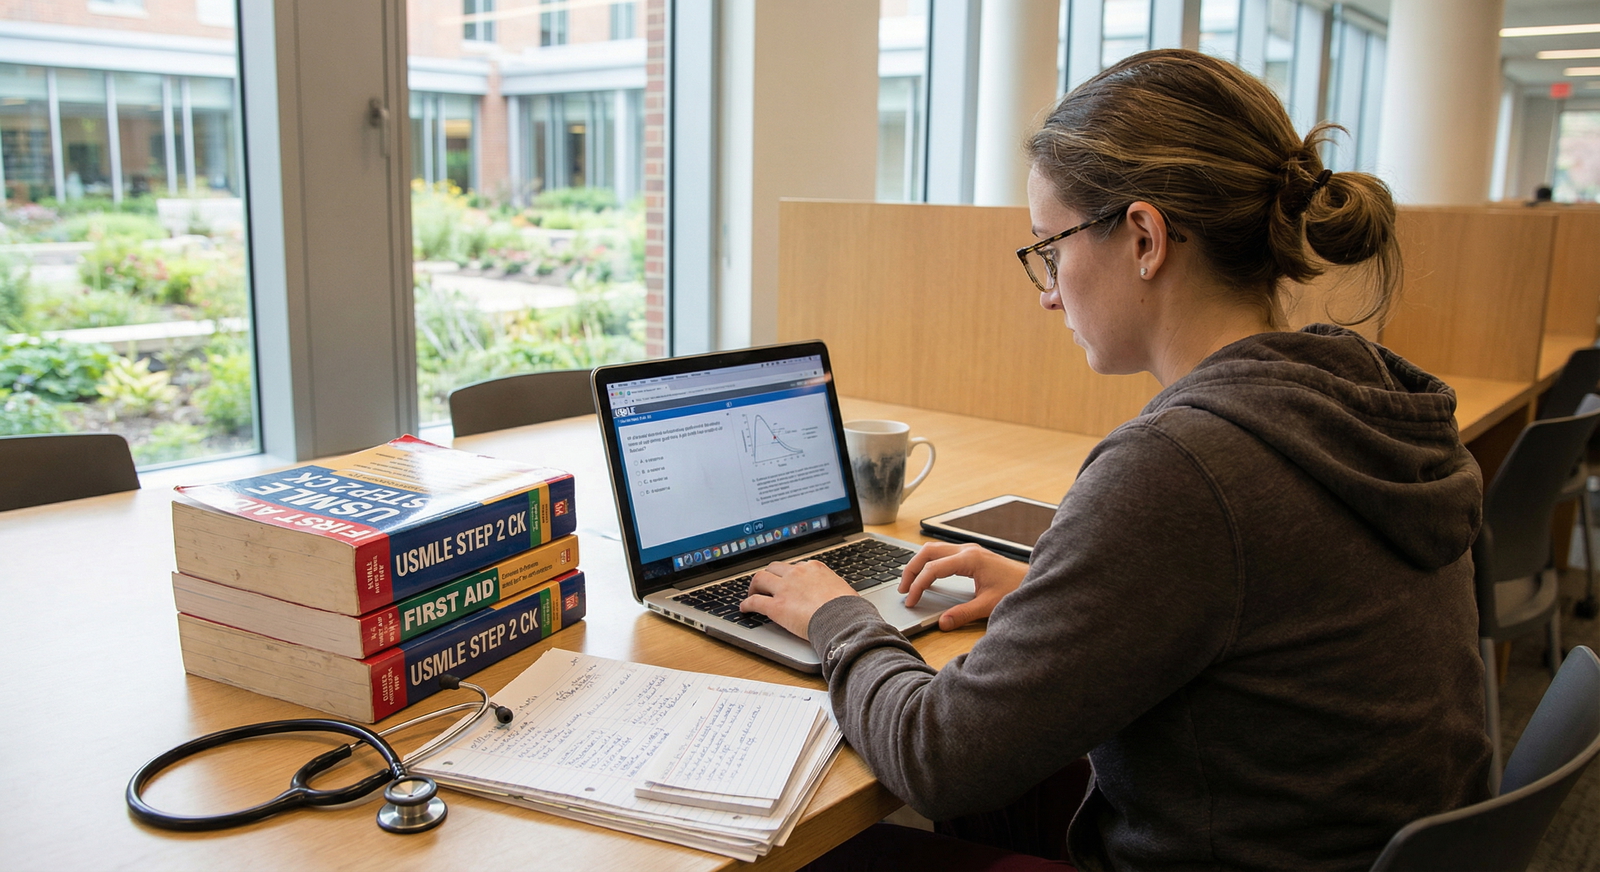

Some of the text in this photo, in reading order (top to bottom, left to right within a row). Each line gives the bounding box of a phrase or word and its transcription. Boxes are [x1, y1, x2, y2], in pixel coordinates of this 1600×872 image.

[283, 472, 338, 488] CK
[233, 499, 370, 541] FIRST AID
[244, 482, 400, 523] USMLE
[396, 537, 453, 577] USMLE
[456, 523, 494, 555] STEP
[496, 519, 506, 542] 2
[508, 511, 527, 537] CK
[404, 591, 459, 631] FIRST
[410, 641, 467, 686] USMLE
[470, 624, 506, 658] STEP
[509, 618, 518, 641] 2
[520, 608, 539, 634] CK
